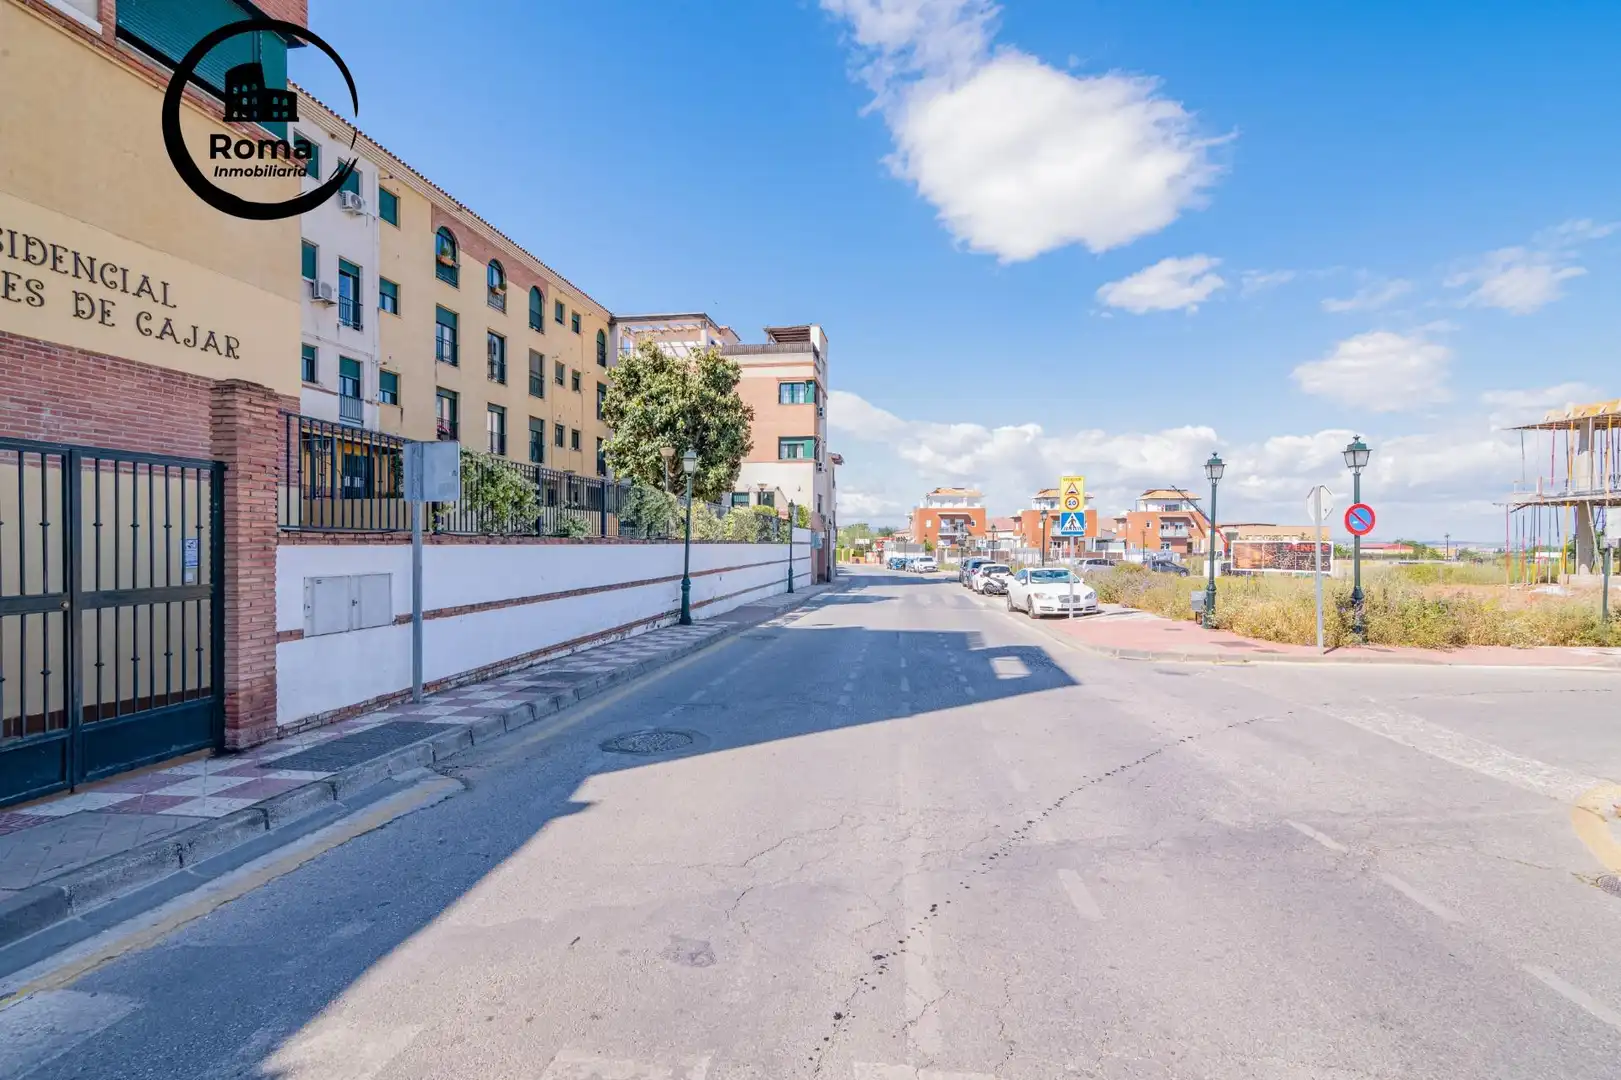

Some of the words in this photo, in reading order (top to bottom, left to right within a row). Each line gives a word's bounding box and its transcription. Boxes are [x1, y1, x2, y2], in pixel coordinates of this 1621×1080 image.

[0, 227, 177, 309] IDENCIAL
[72, 289, 116, 328] DE
[135, 310, 241, 360] CAJAR
